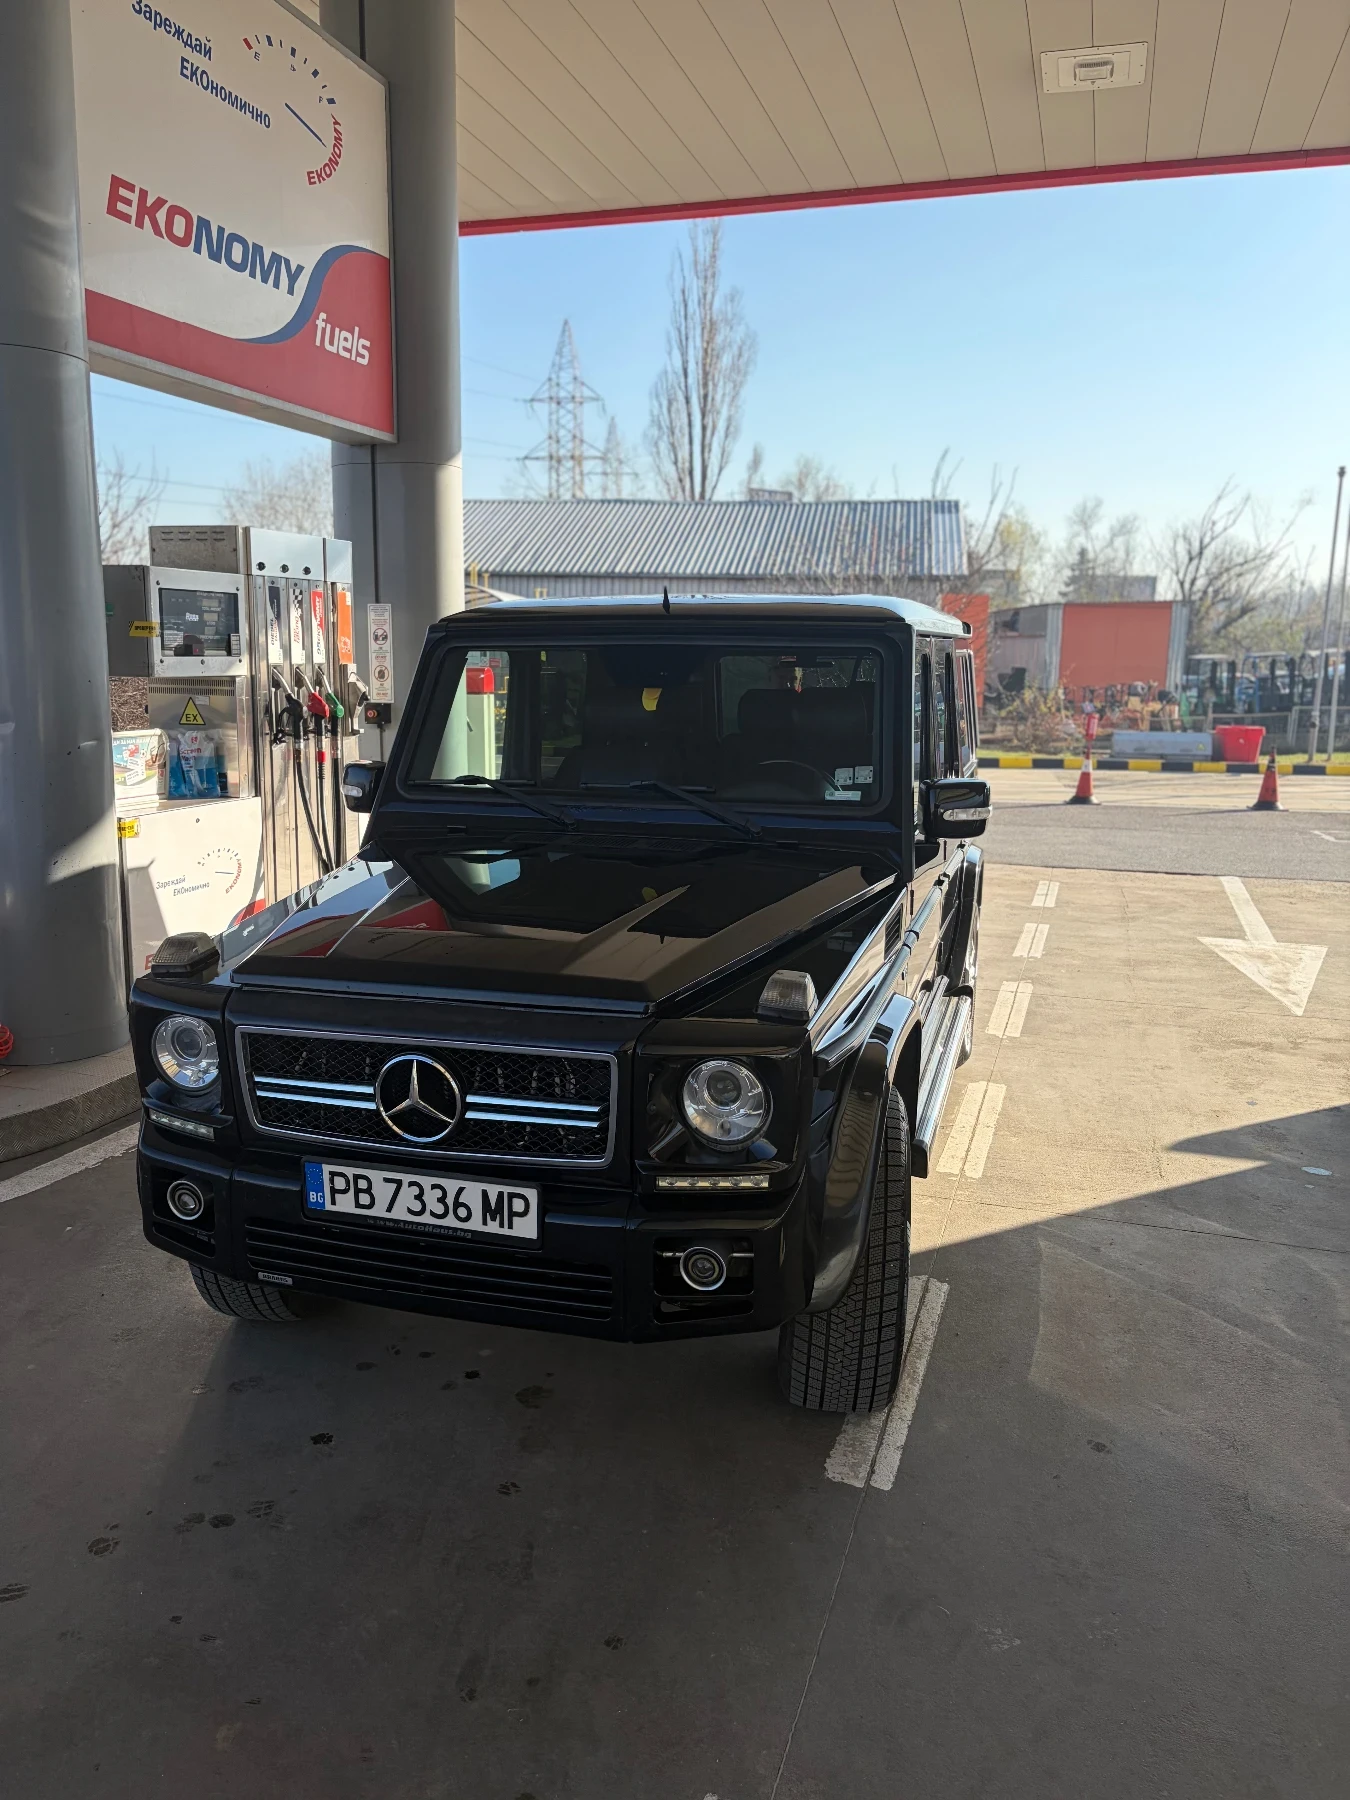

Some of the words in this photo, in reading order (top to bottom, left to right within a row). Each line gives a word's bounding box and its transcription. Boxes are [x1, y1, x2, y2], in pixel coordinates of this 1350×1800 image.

[132, 0, 212, 61] Зареждай
[180, 55, 271, 129] ЕКОномично
[307, 113, 343, 186] EKONOMY
[105, 174, 305, 297] EKONOMY
[315, 312, 371, 366] fuels
[185, 713, 199, 723] EX
[156, 875, 186, 890] Зареждай
[173, 882, 210, 897] ЕКОномично
[225, 858, 242, 894] EKONOMY
[309, 1191, 324, 1203] BG
[328, 1170, 375, 1210] PB
[382, 1177, 473, 1223] 7336
[481, 1188, 530, 1230] MP
